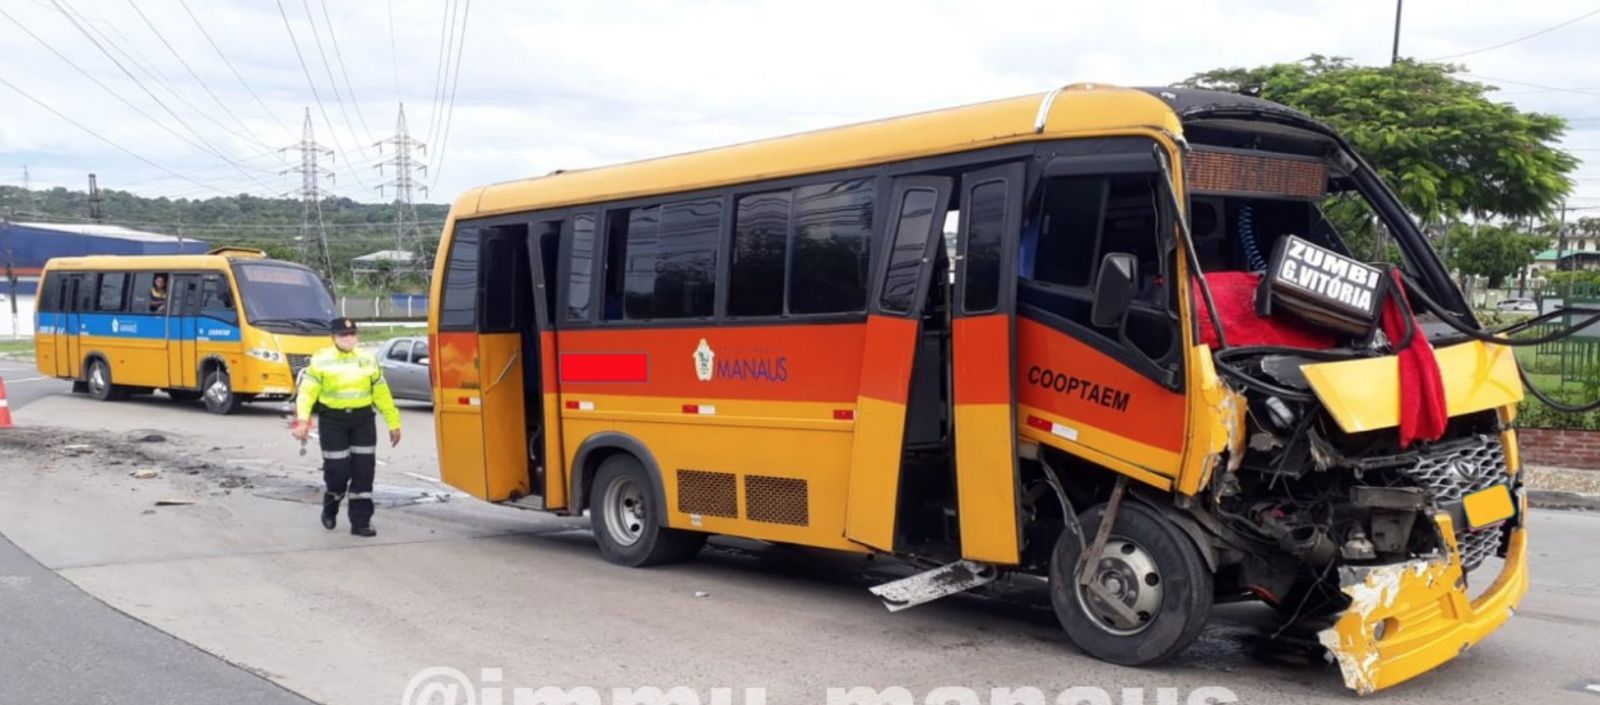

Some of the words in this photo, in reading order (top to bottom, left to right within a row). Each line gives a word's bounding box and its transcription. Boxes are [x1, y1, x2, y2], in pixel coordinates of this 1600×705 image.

[1282, 259, 1372, 311] G.VITÓRIA
[1288, 240, 1380, 290] ZUMBI
[717, 355, 788, 382] MANAUS
[1028, 365, 1131, 412] COOPTAEM
